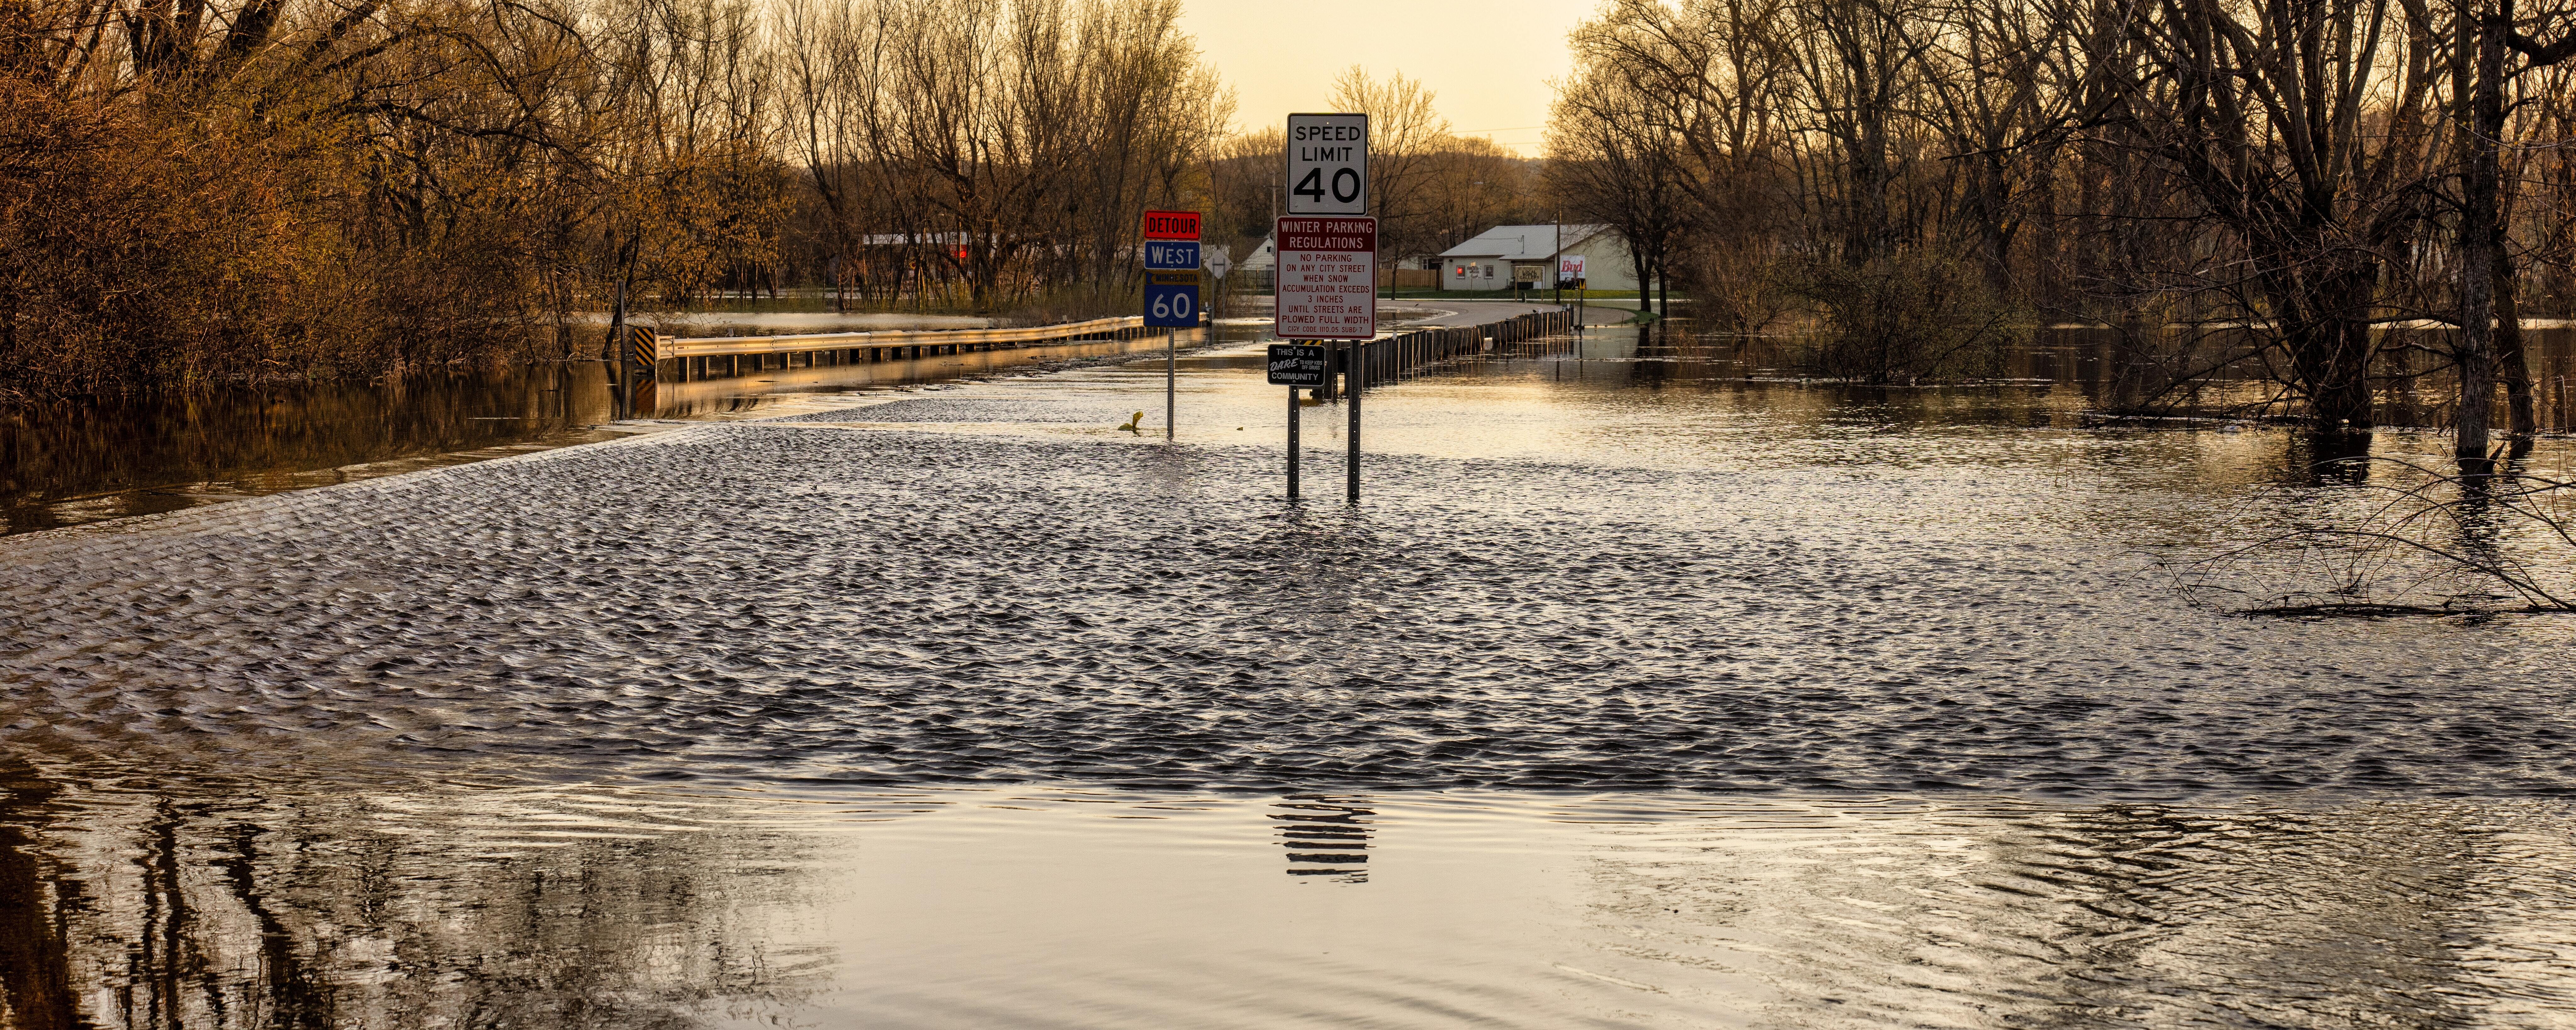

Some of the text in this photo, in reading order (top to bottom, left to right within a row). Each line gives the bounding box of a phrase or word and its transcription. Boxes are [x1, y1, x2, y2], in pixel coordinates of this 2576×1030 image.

[1295, 126, 1360, 141] SPEED
[1302, 147, 1352, 161] LIMIT
[1293, 168, 1360, 203] 40
[1149, 217, 1196, 234] DETOUR
[1281, 221, 1372, 233] WINTER PARKING
[1290, 237, 1363, 248] REGULATIONS
[1152, 246, 1194, 264] WEST
[1561, 260, 1583, 273] Bud
[1155, 274, 1198, 282] MINNESOTA
[1282, 285, 1335, 293] ACCUMULATION
[1153, 293, 1190, 318] 60
[1270, 358, 1298, 371] D.A.R.E.
[1271, 372, 1319, 380] COMMUNITY
